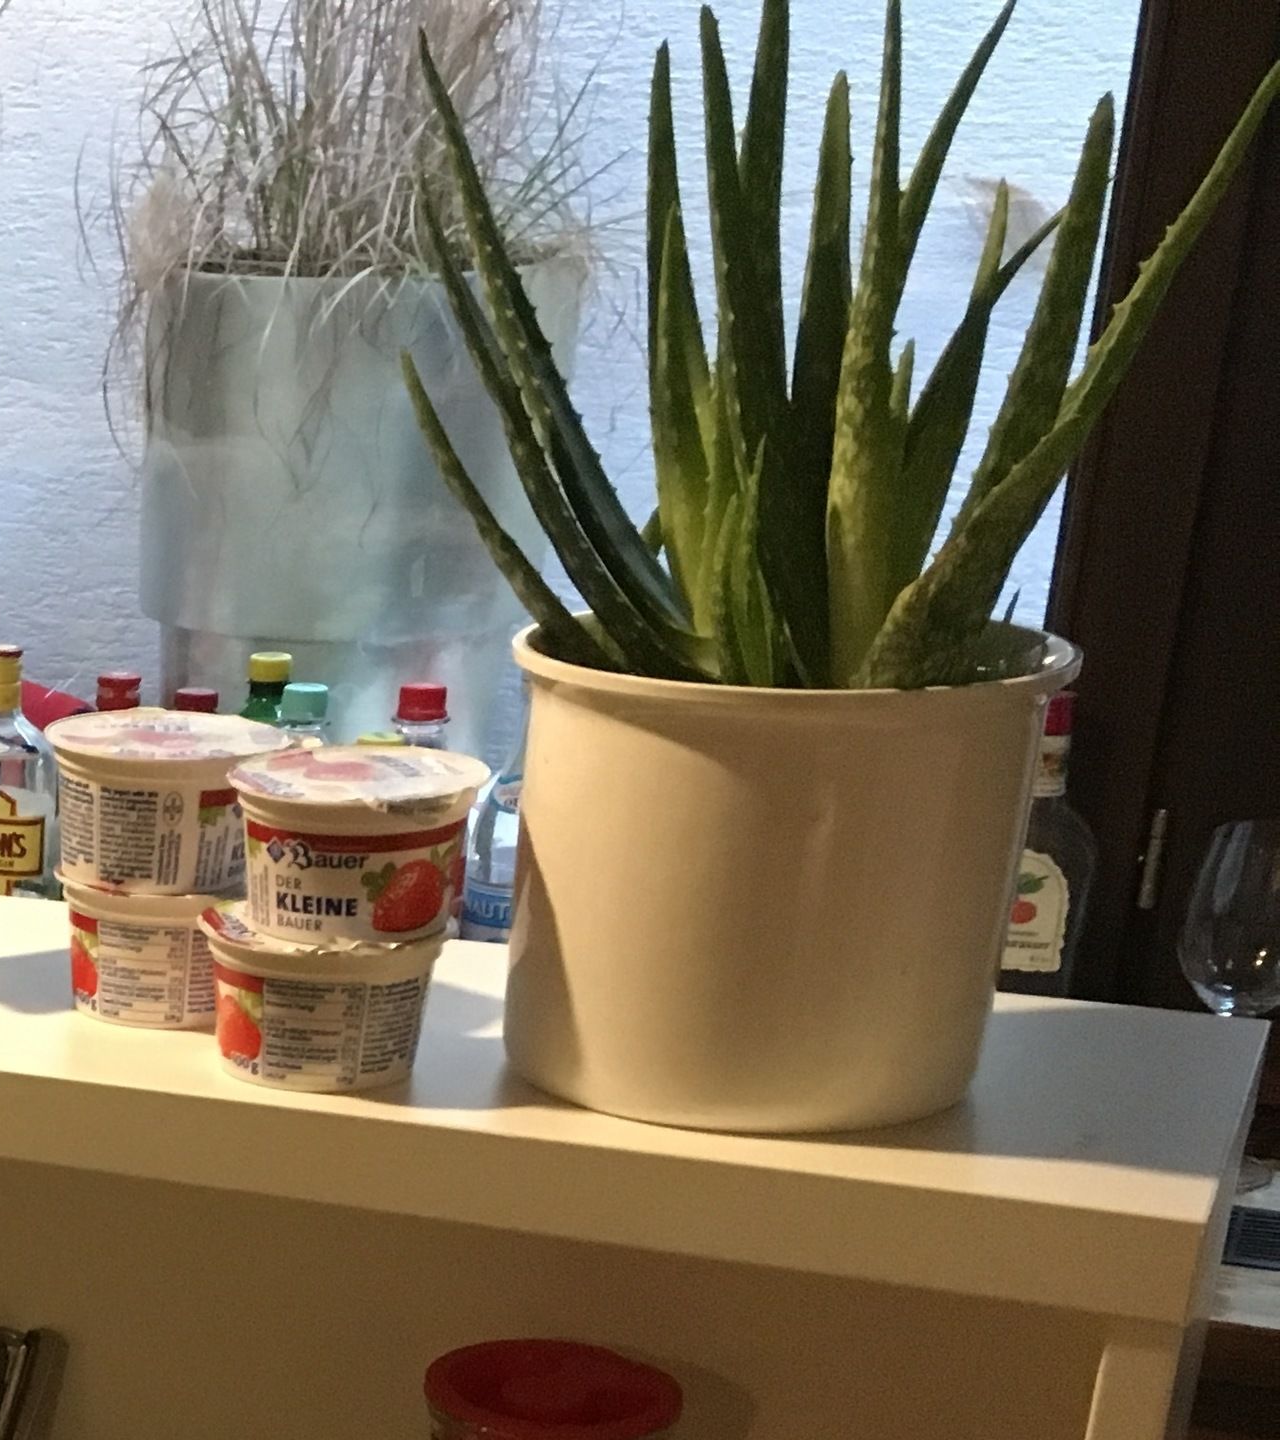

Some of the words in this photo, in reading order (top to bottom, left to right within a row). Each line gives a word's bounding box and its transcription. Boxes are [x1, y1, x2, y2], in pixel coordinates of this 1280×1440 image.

[284, 839, 370, 870] Bauer
[275, 874, 302, 890] DER
[276, 891, 357, 917] KLEINE
[277, 914, 323, 932] BAUER
